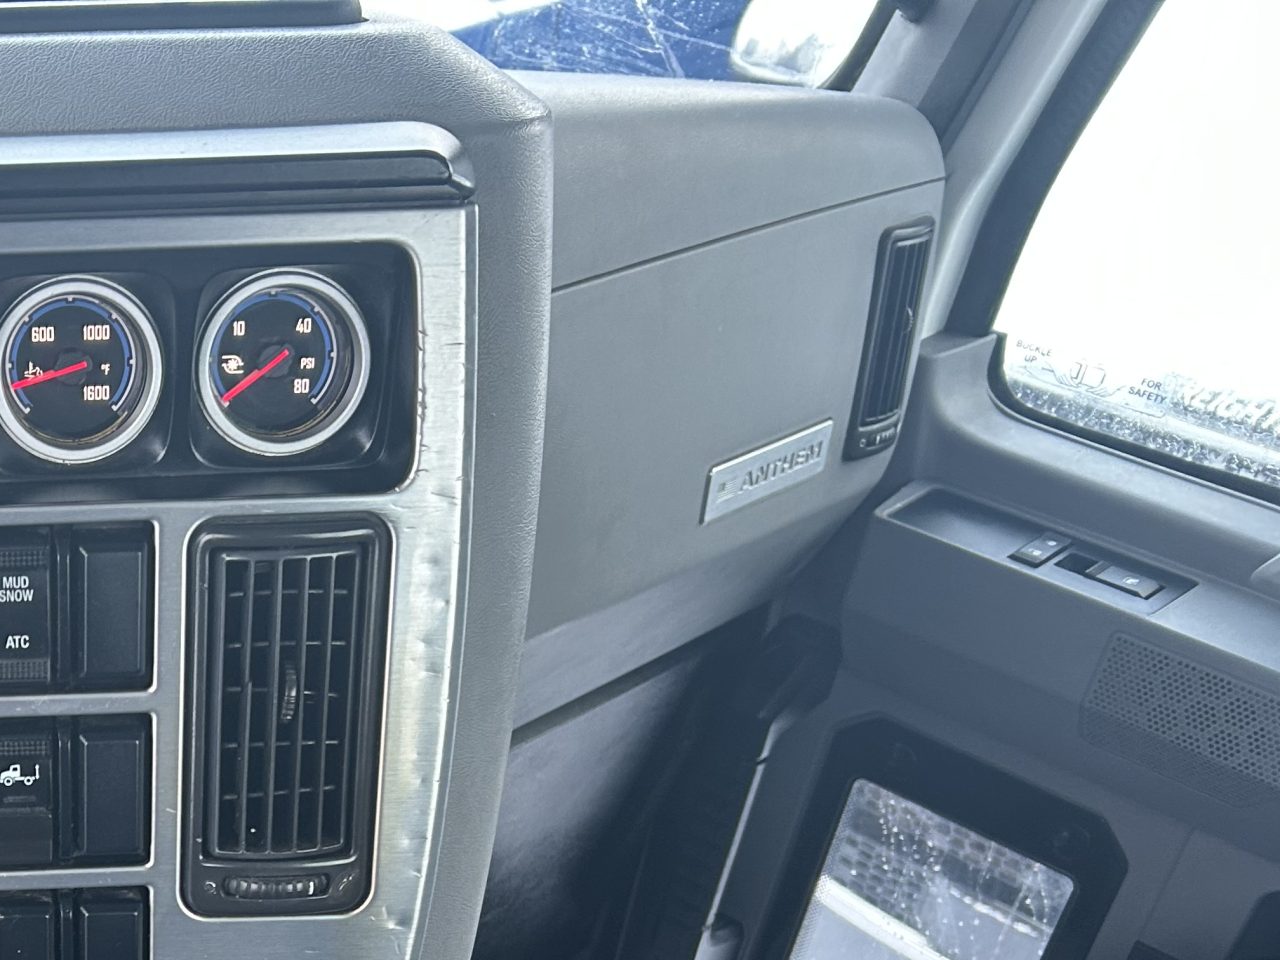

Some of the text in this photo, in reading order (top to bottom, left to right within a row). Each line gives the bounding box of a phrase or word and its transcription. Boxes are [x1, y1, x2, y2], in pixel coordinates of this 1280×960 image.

[30, 324, 111, 343] 600 1000
[232, 317, 313, 336] 10 40
[300, 357, 315, 370] PSI
[1024, 355, 1037, 363] UP
[293, 378, 310, 394] 80
[1141, 377, 1163, 391] FOR
[82, 384, 110, 401] 1600
[1128, 386, 1168, 404] SAFETY
[739, 440, 824, 493] ANTHEM
[2, 575, 29, 589] MUD
[5, 634, 30, 649] ATC
